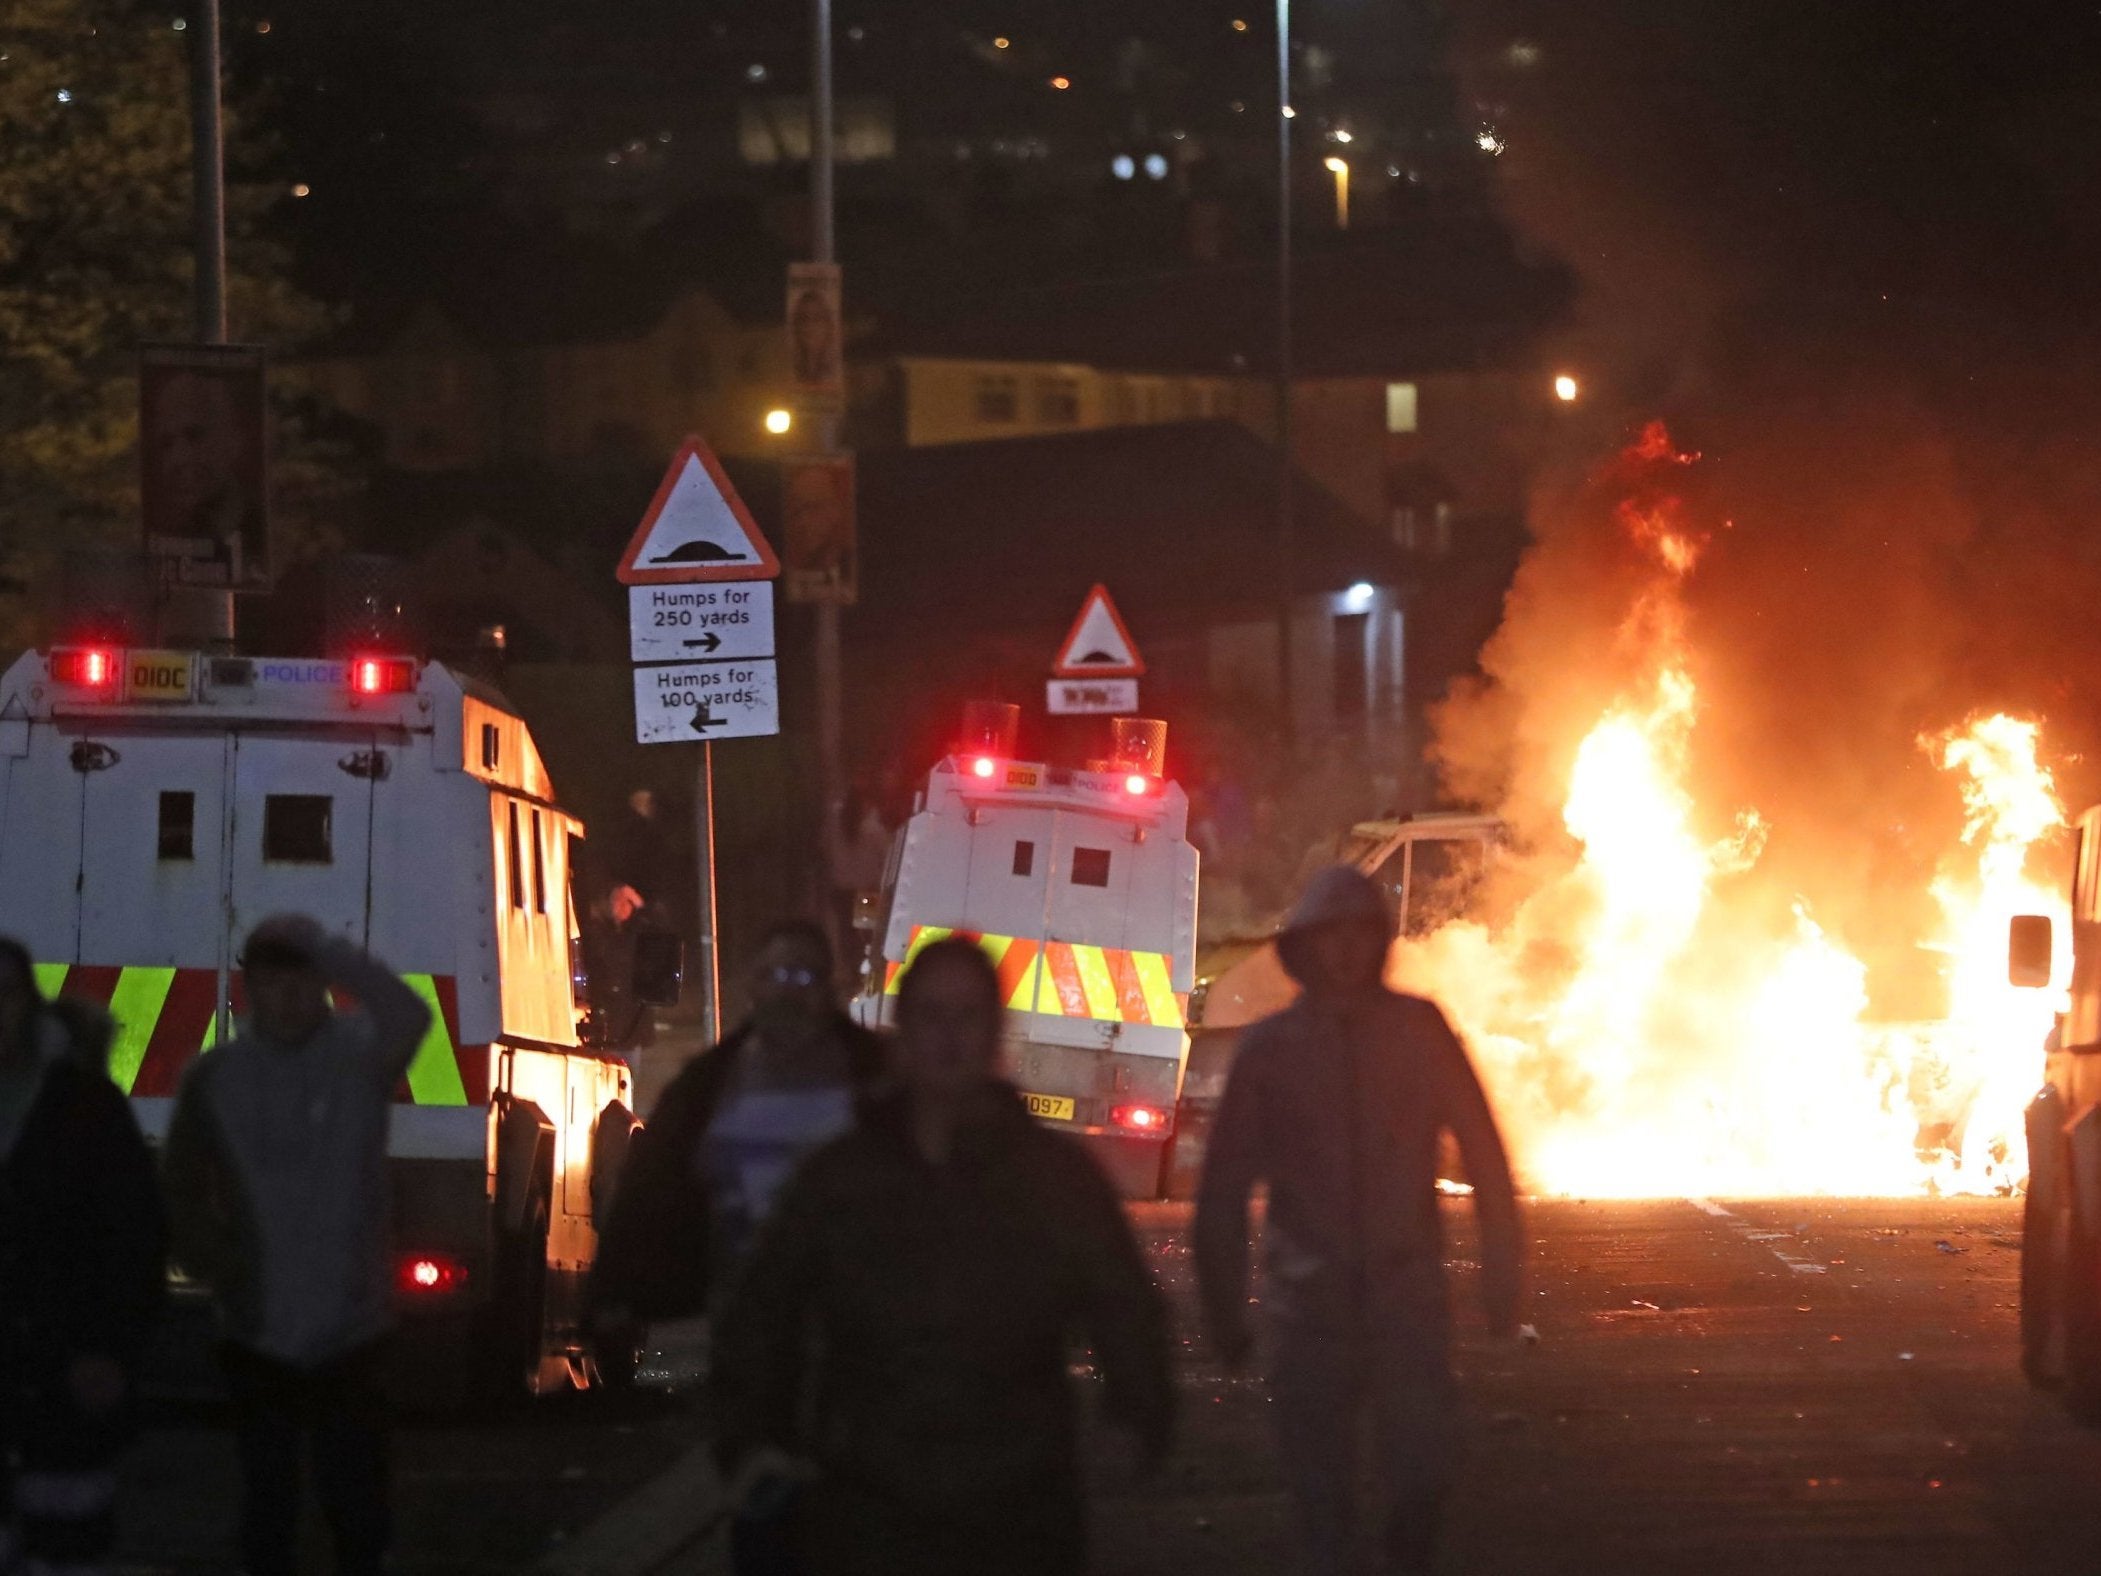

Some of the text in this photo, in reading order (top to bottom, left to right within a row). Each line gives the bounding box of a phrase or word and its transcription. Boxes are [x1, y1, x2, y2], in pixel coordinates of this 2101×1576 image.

[653, 589, 751, 608] Humps for
[654, 610, 750, 628] 250 yards
[263, 666, 342, 685] POLICE
[657, 669, 754, 688] Humps for
[661, 689, 753, 708] 100 yards
[1025, 1096, 1063, 1115] 097
